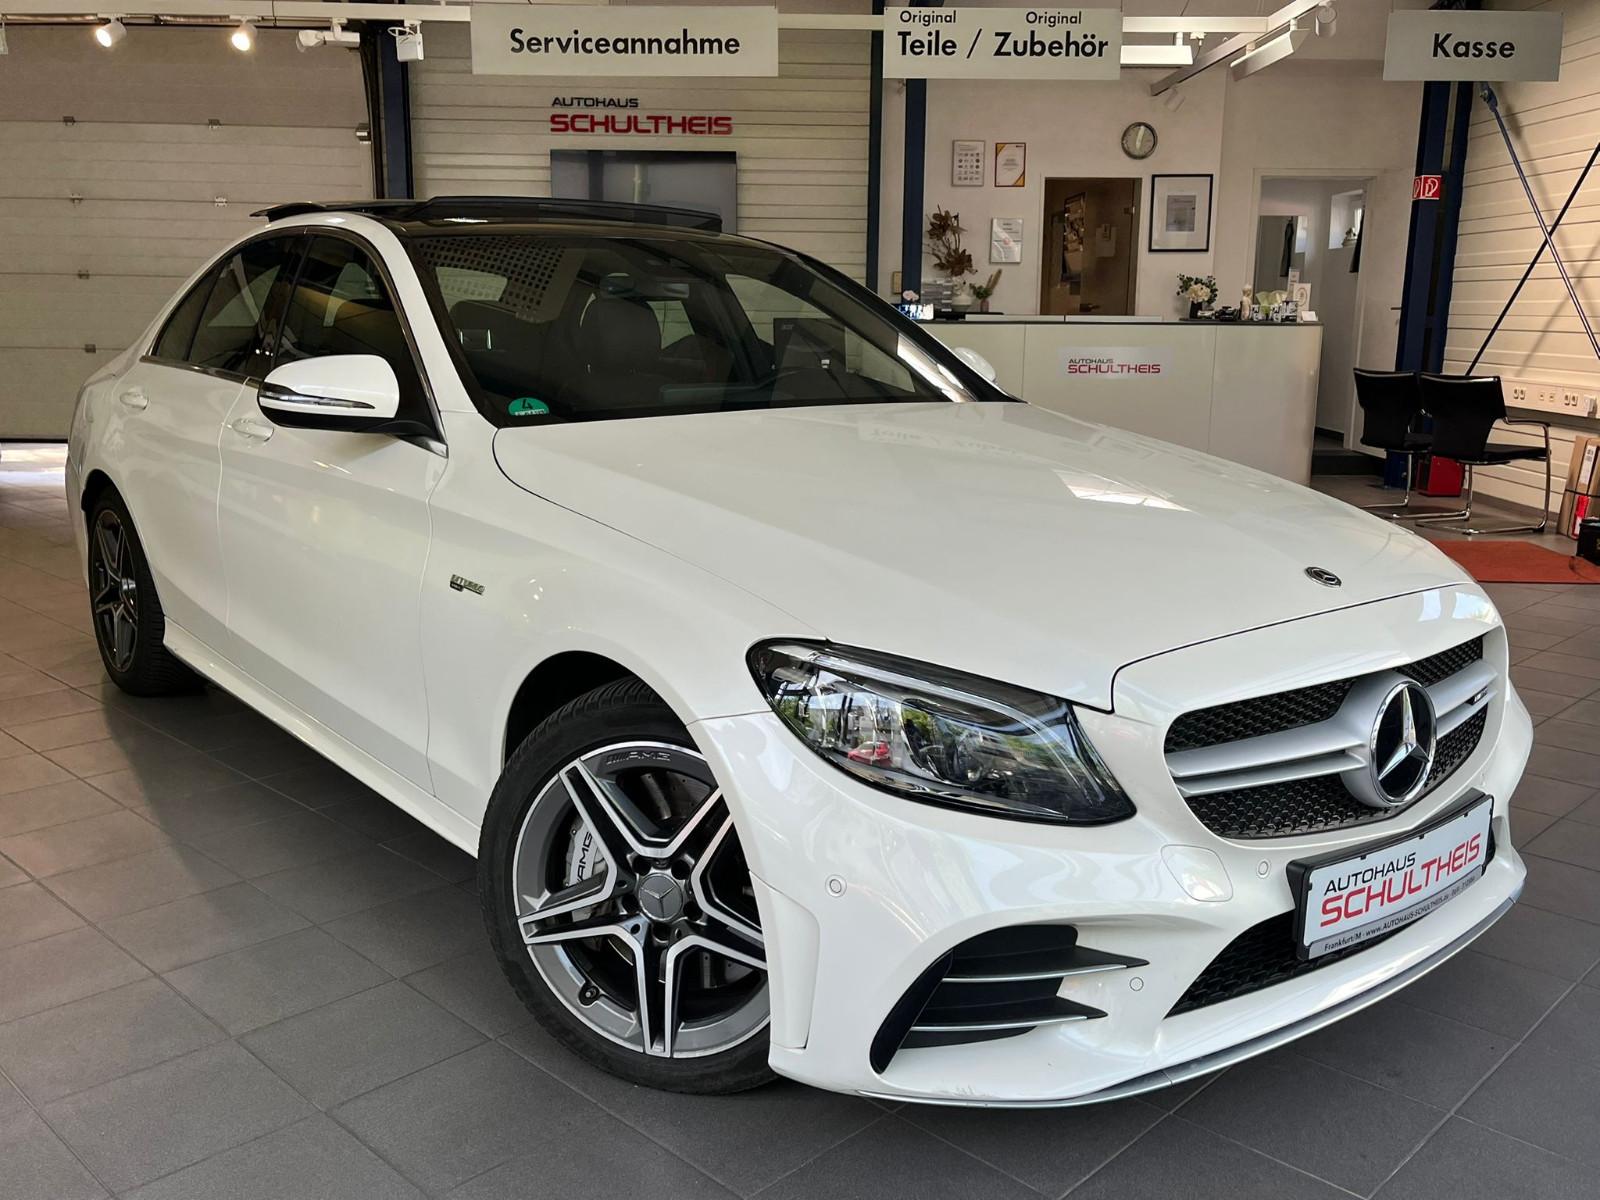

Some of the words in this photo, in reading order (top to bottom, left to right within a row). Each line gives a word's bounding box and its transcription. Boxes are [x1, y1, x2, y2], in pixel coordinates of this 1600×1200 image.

[900, 10, 957, 27] Original
[1025, 11, 1082, 28] Original
[510, 28, 740, 55] Serviceannahme
[897, 30, 957, 57] Teile
[966, 28, 983, 59] /
[993, 31, 1109, 58] Zubehör
[1432, 33, 1515, 59] Kasse
[551, 97, 639, 109] AUTOHAUS
[550, 114, 733, 135] SCHULTHEIS
[1067, 364, 1161, 374] SCHULTHEIS
[1320, 833, 1481, 928] SCHULTHEIS
[1324, 852, 1416, 896] AUTOHAUS
